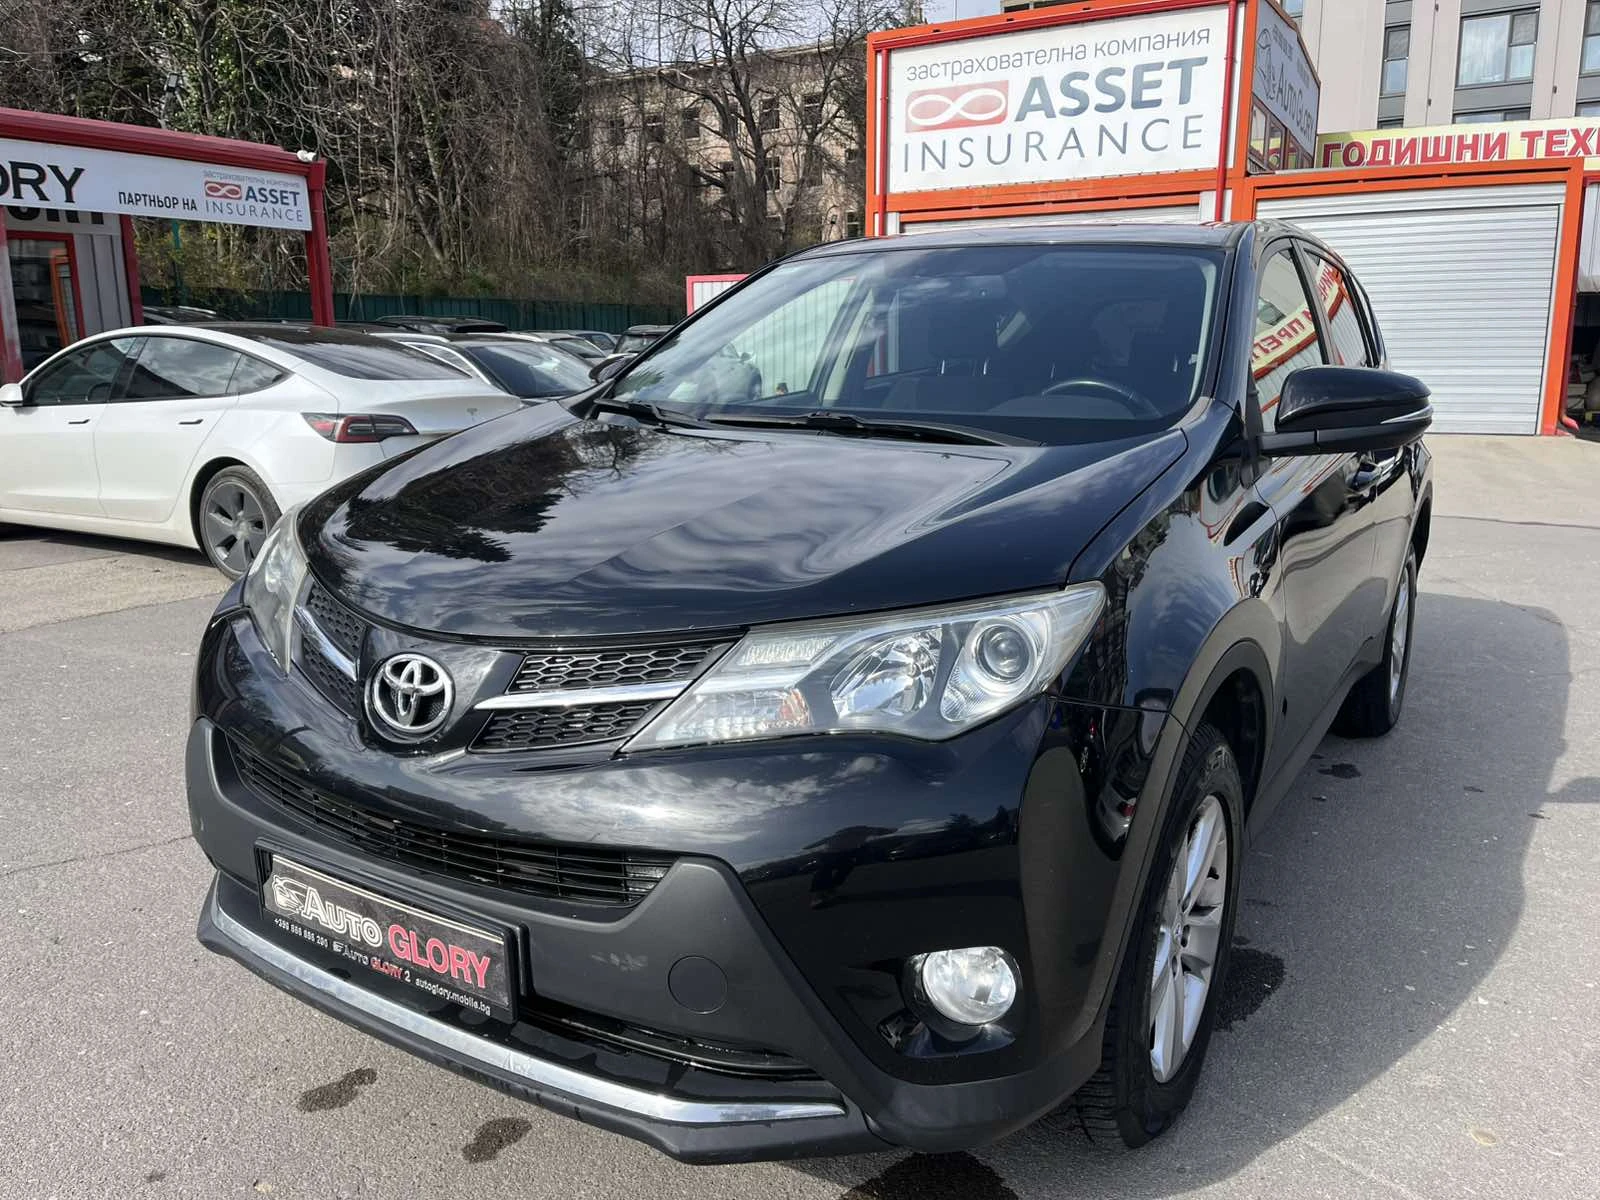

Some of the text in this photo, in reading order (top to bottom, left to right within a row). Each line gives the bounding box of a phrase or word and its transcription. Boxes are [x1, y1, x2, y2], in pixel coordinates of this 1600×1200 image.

[905, 27, 1210, 81] застрахователна компания
[1014, 56, 1209, 122] ASSET
[903, 114, 1204, 173] INSURANCE
[1323, 126, 1600, 169] ГОДИШНИ ТЕХ
[118, 191, 198, 212] ПАРТНЬОР НА
[205, 200, 303, 223] INSURANCE
[245, 185, 301, 207] ASSET
[300, 885, 491, 990] AUTO GLORY
[403, 969, 412, 983] 2
